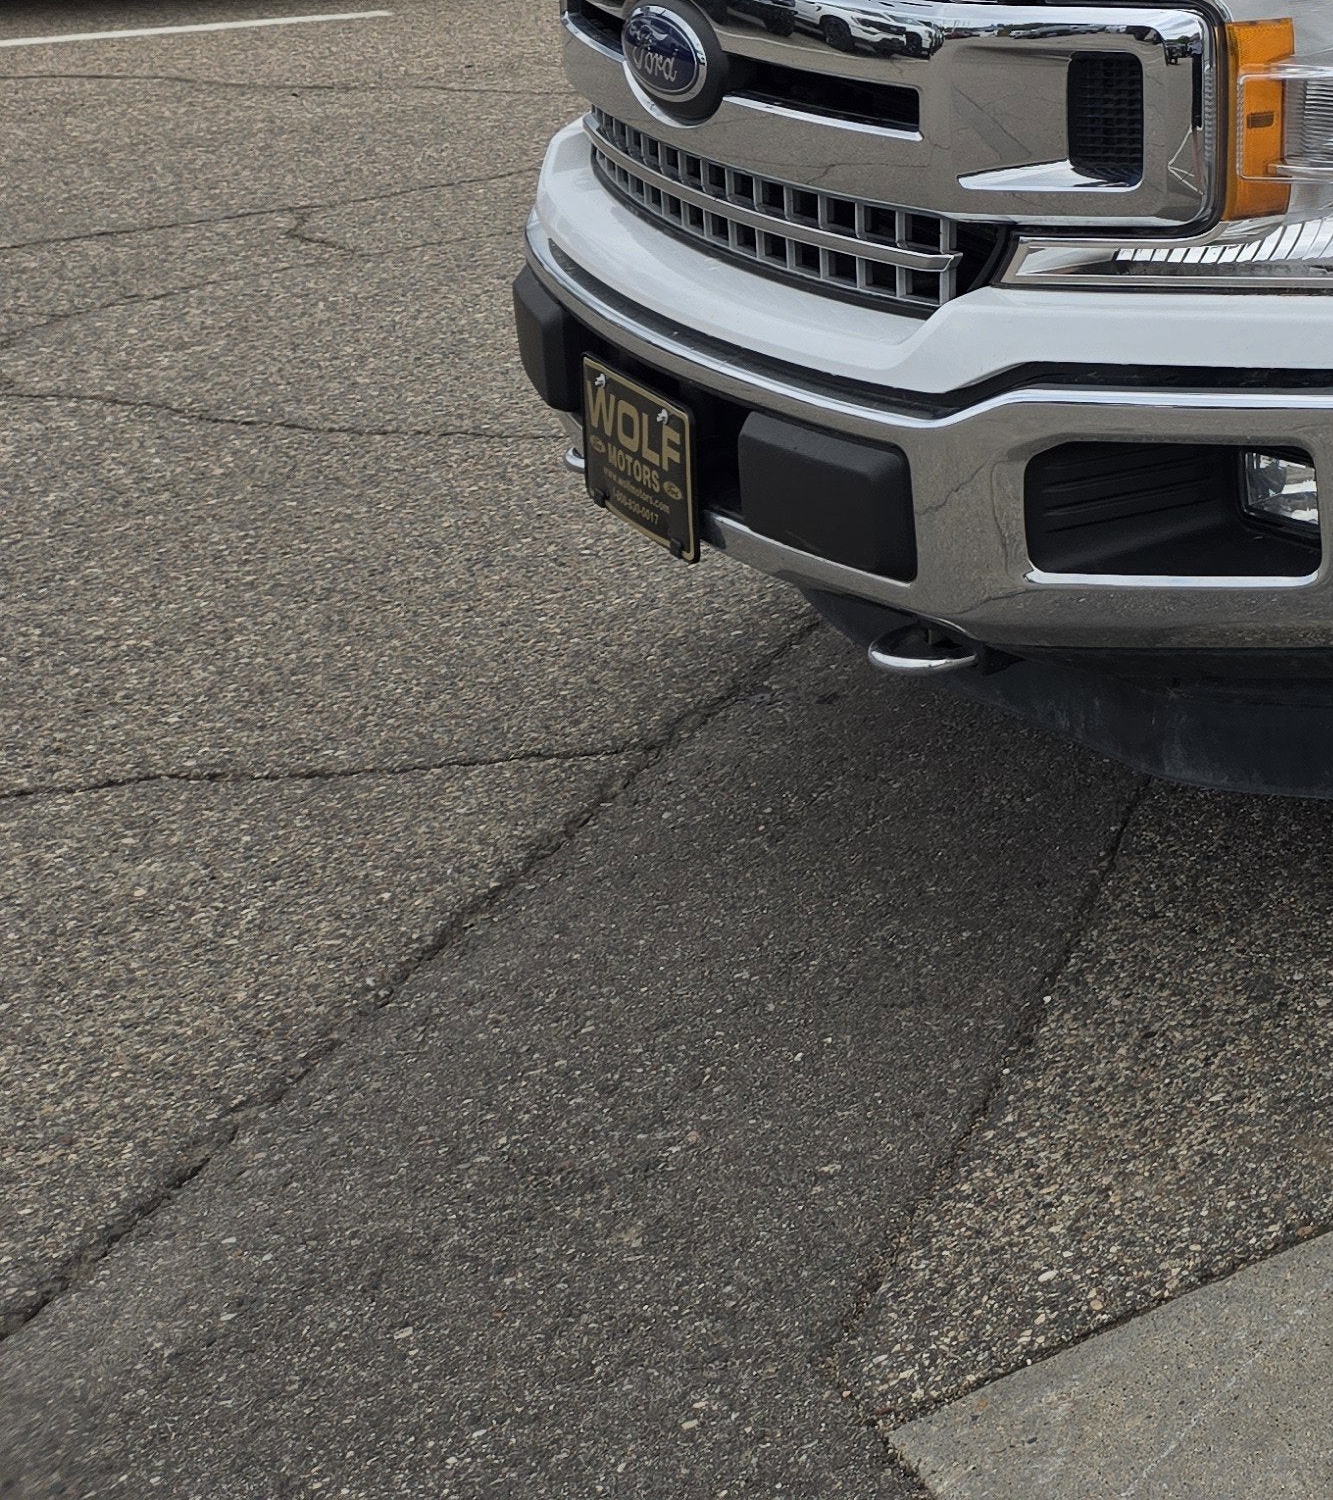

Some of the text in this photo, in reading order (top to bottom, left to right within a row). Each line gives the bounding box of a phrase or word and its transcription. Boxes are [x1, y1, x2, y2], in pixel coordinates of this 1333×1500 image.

[629, 20, 677, 82] Ford
[586, 380, 681, 472] WOLF
[608, 443, 660, 493] MOTORS
